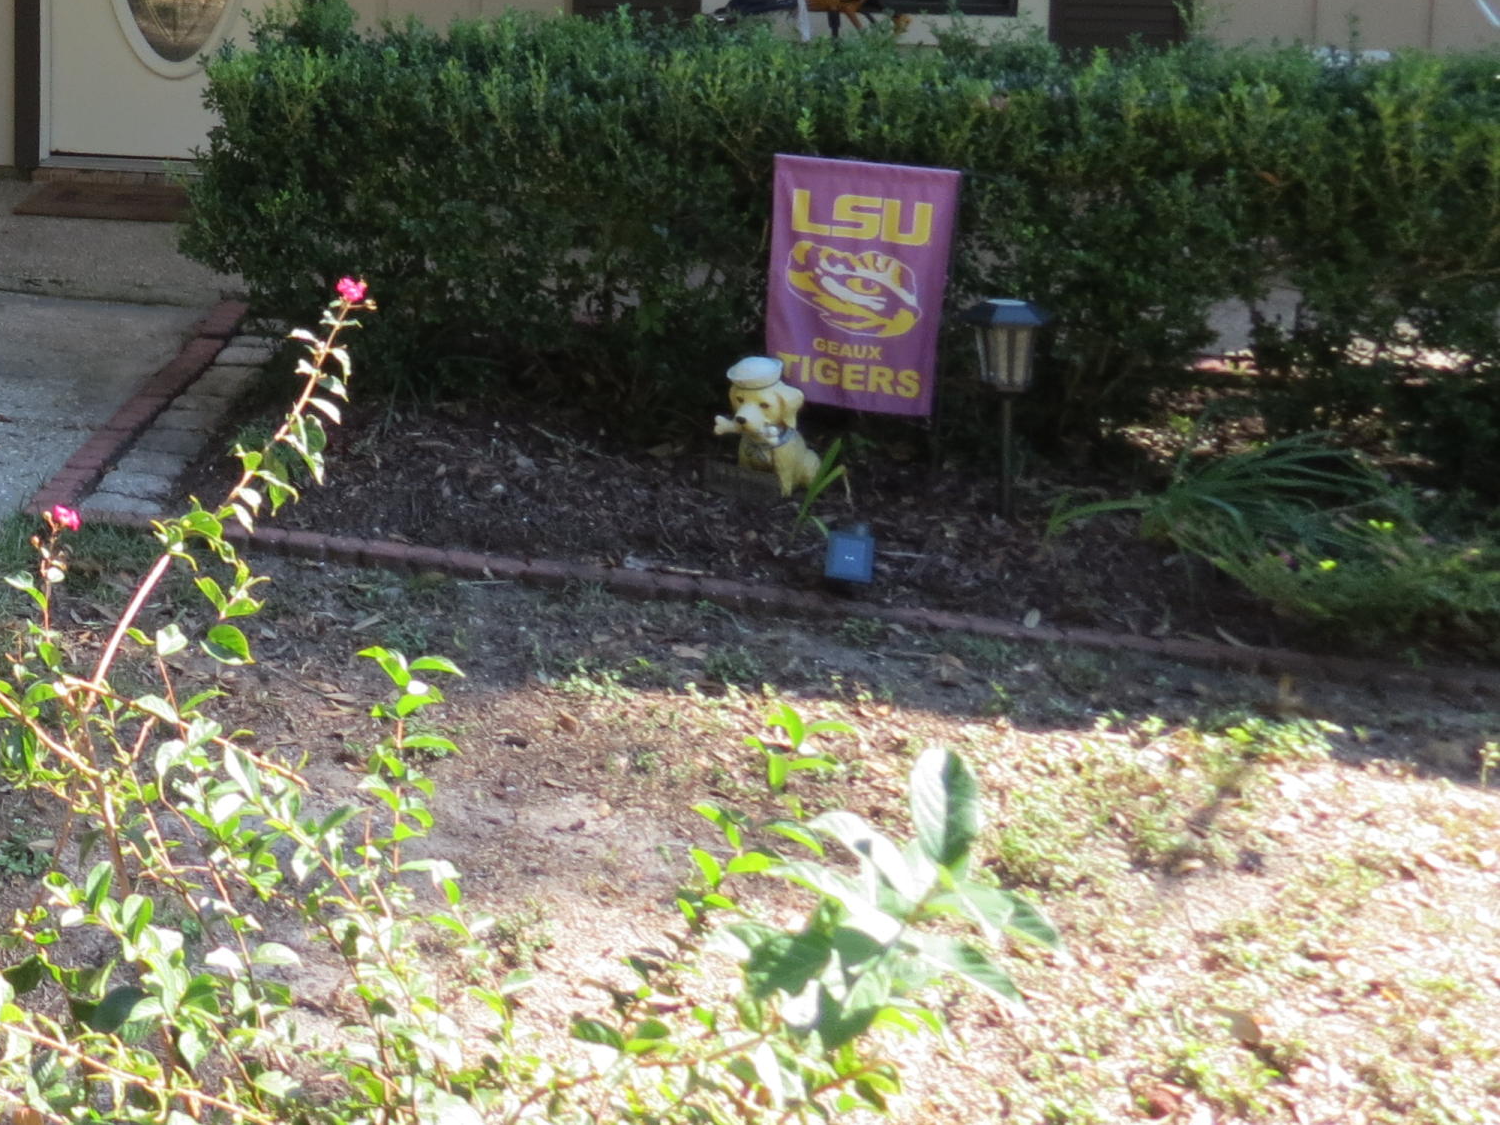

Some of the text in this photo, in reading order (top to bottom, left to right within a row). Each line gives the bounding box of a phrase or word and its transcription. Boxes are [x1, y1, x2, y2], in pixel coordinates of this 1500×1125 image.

[791, 188, 933, 246] LSU
[813, 338, 883, 360] GEAUX
[777, 352, 921, 399] TIGERS
